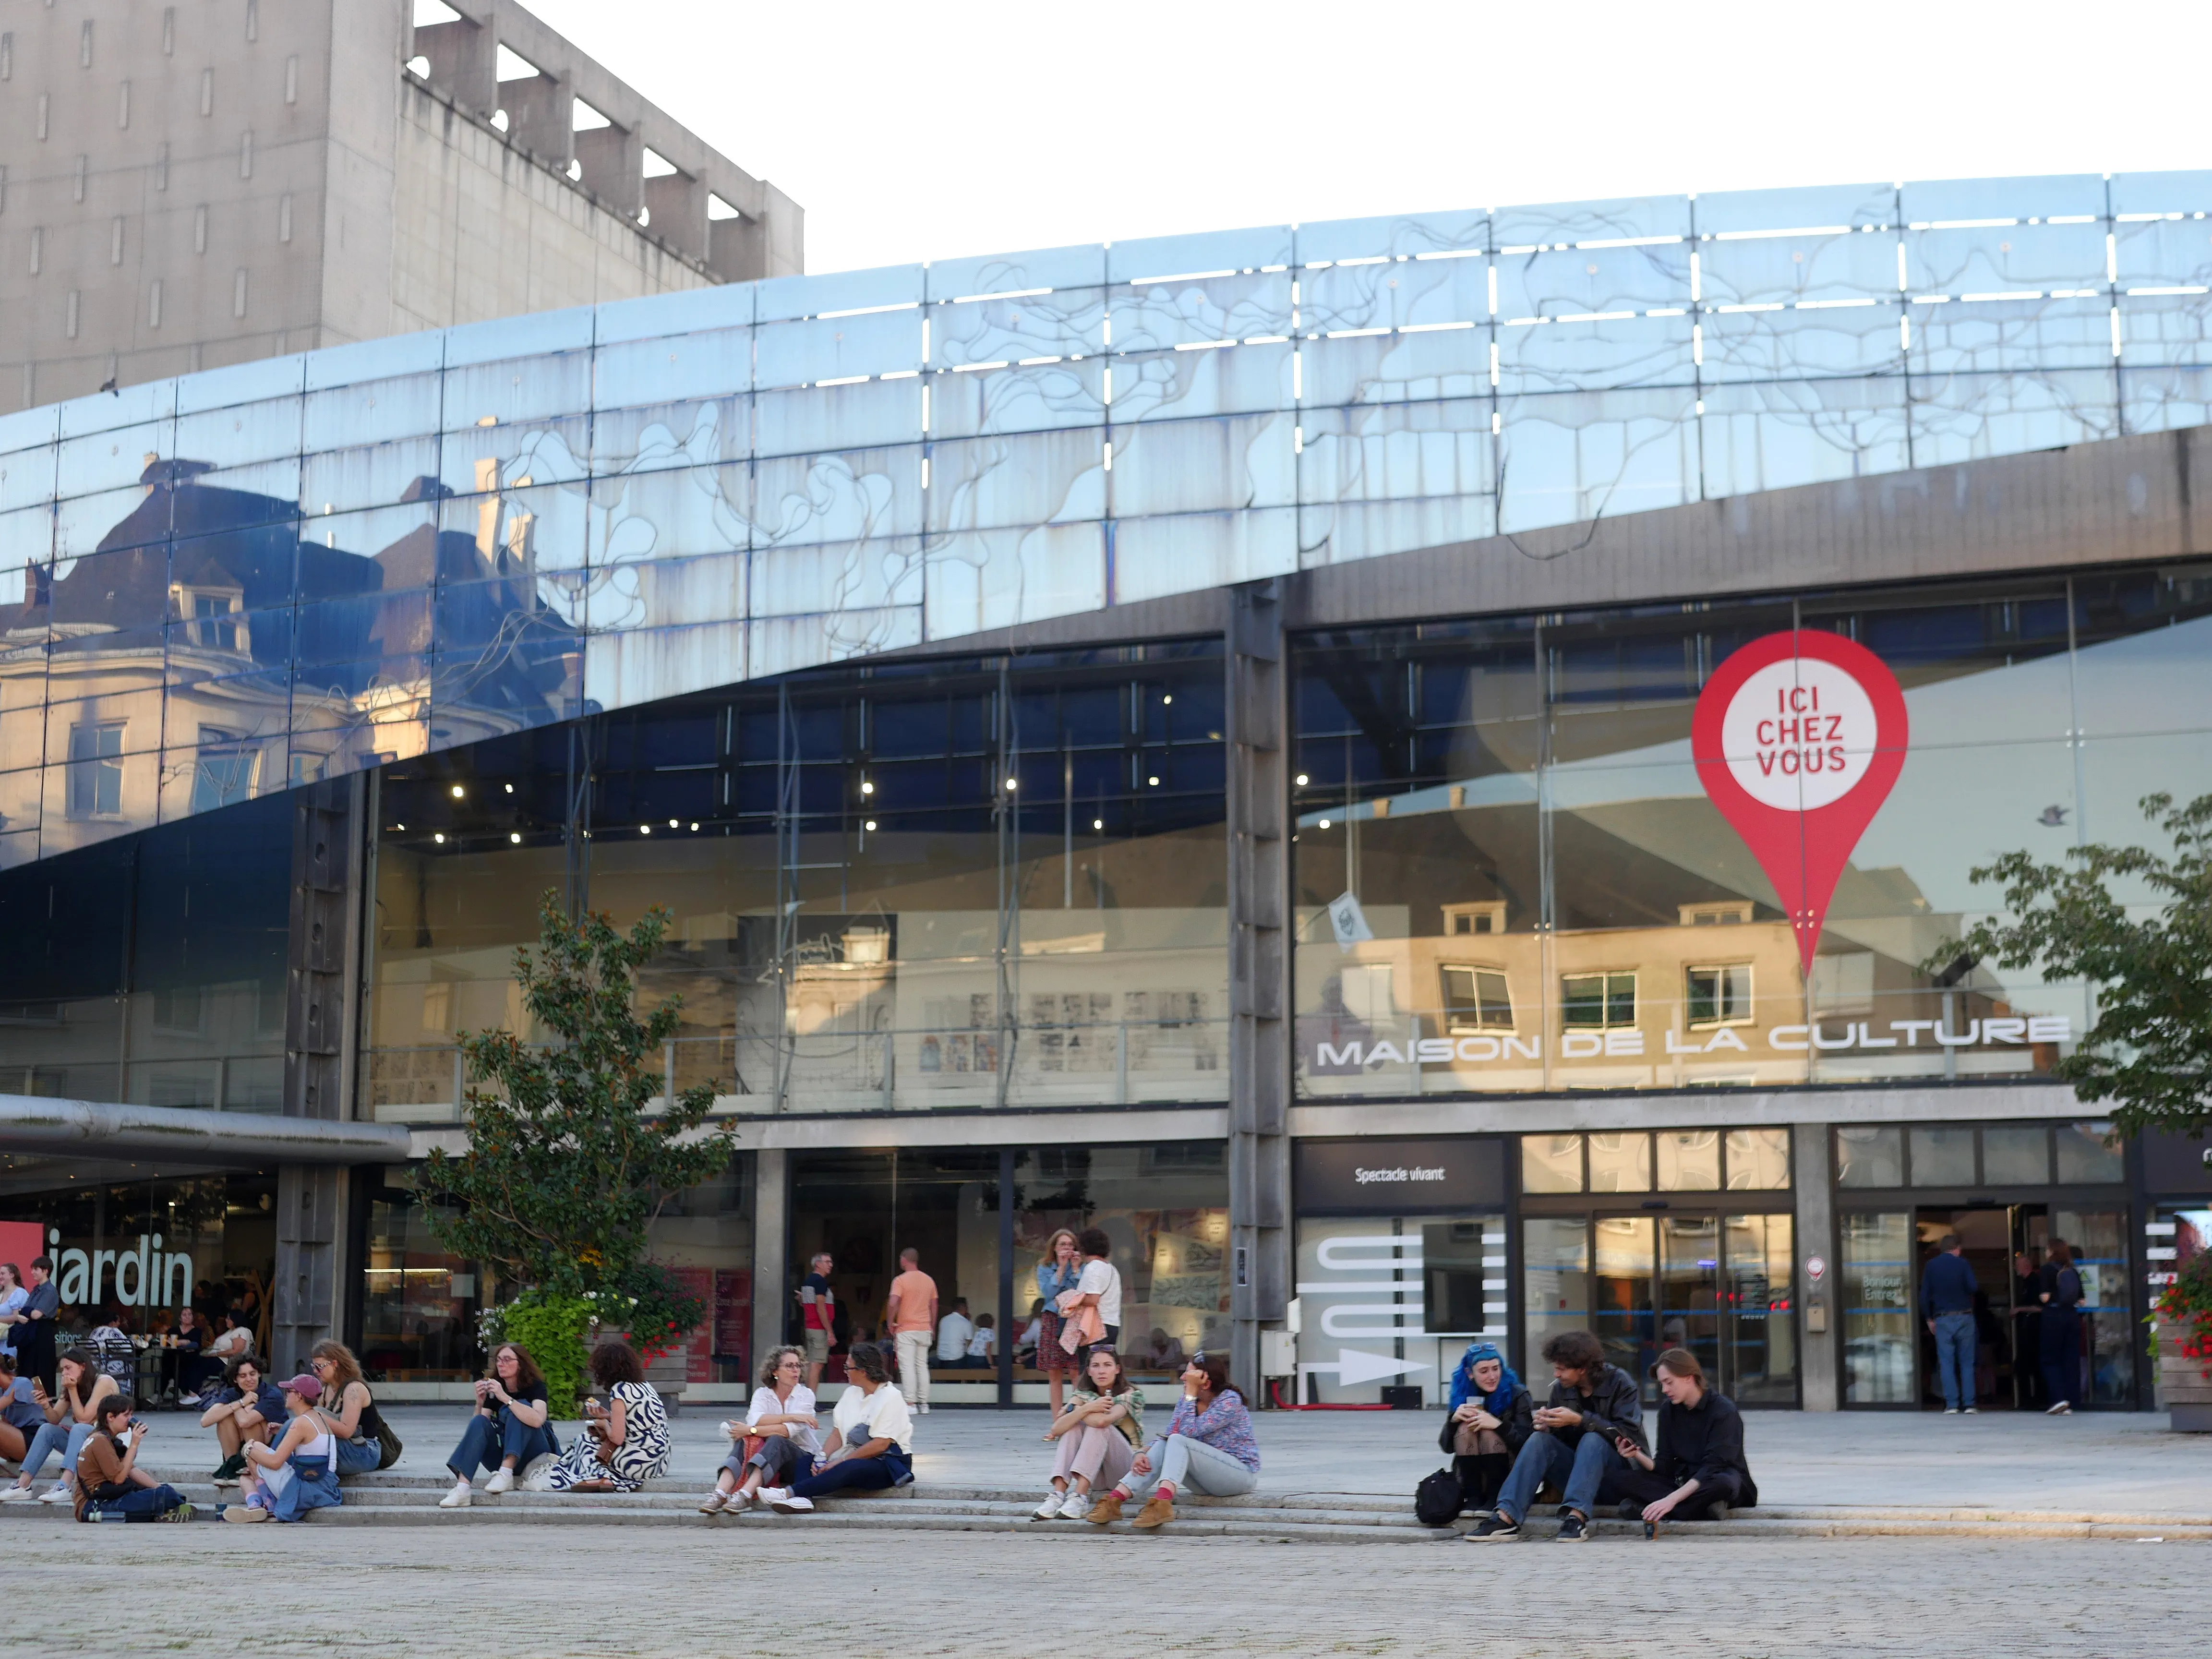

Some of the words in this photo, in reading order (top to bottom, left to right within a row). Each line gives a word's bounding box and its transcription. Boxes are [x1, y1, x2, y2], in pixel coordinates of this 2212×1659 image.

[1778, 686, 1818, 713] ICI
[1756, 715, 1842, 745] CHEZ
[1755, 746, 1846, 777] VOUS
[1317, 1035, 1539, 1066] MAISON
[1562, 1031, 1644, 1058] DE
[1665, 1027, 1749, 1054] LA
[1768, 1016, 2071, 1050] CULTURE
[1355, 1166, 1408, 1185] Spectacle
[1409, 1166, 1446, 1181] vivant
[48, 1227, 192, 1307] jardin
